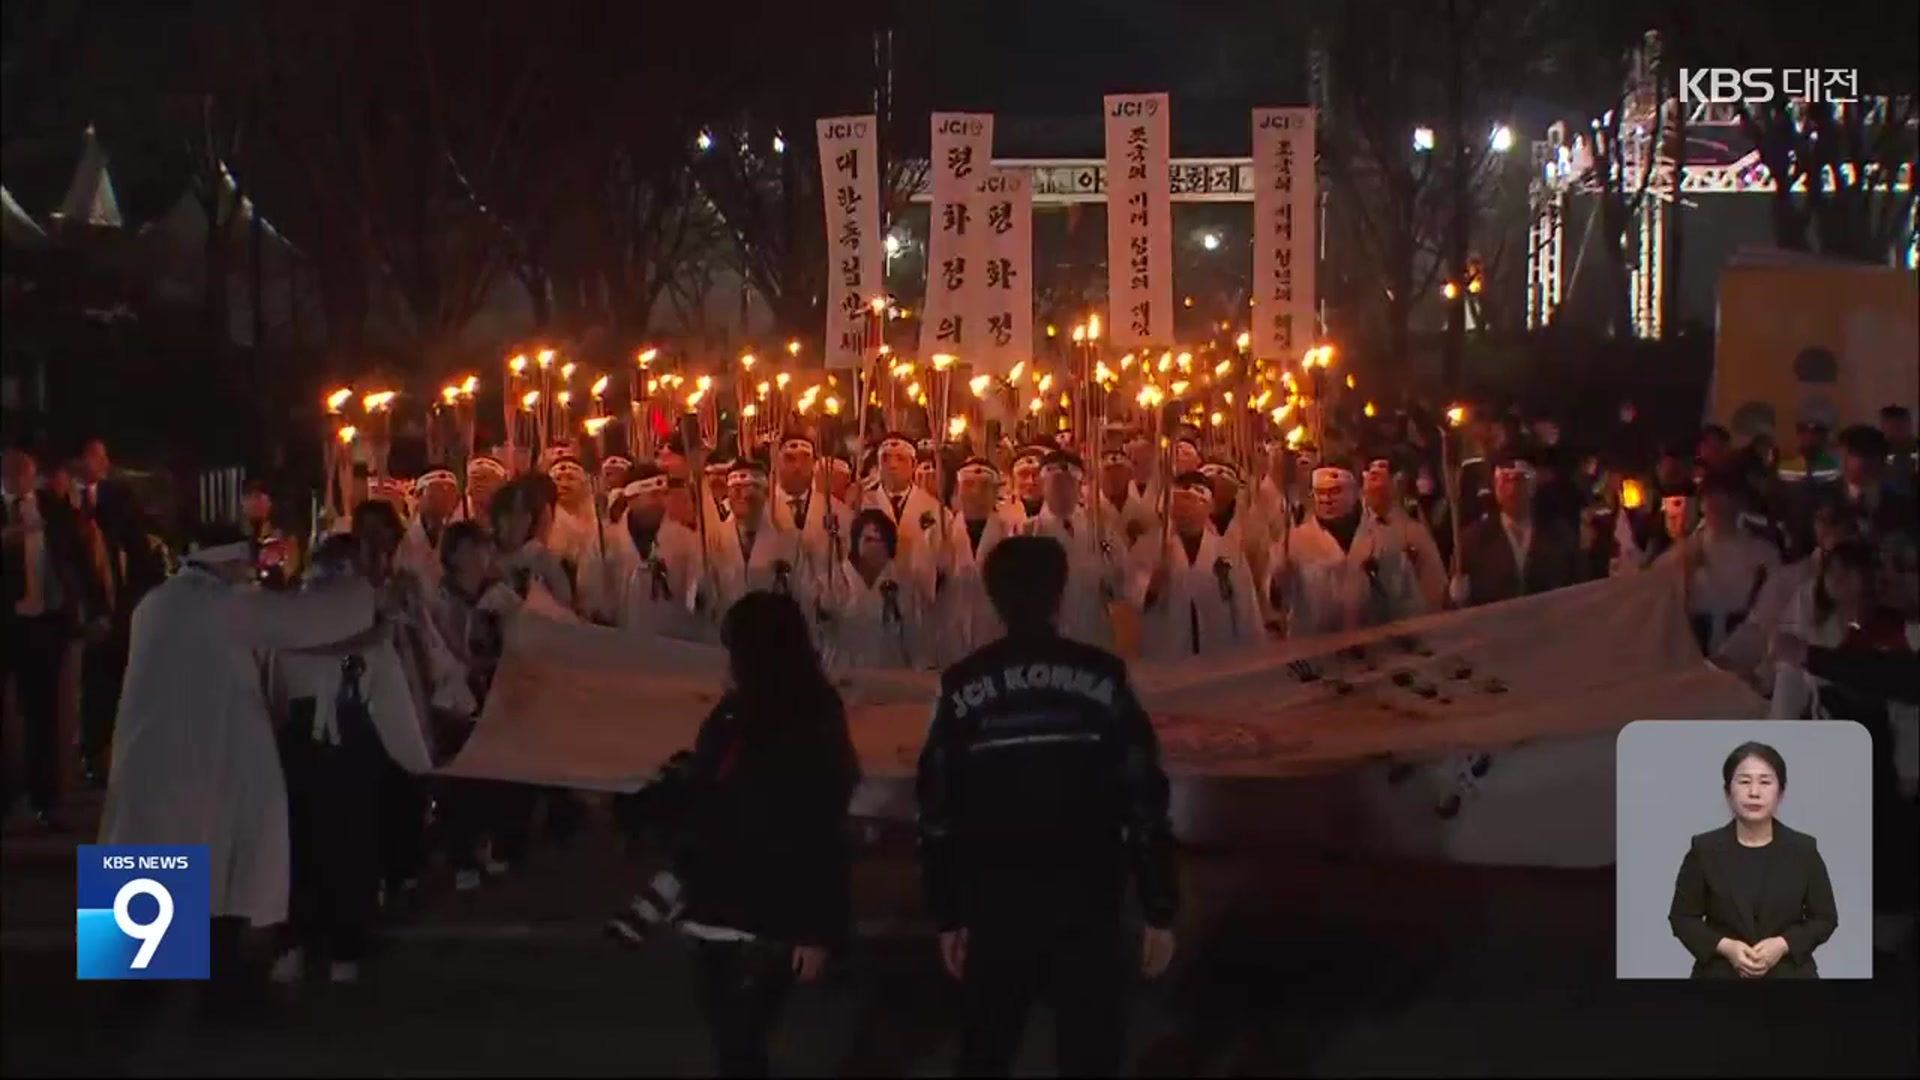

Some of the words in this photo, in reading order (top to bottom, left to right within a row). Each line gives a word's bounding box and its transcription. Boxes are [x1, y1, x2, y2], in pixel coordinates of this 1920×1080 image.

[1112, 102, 1141, 117] JCI
[939, 120, 967, 135] JCI
[1260, 115, 1289, 129] JCI
[825, 123, 851, 139] JCI
[976, 176, 1005, 192] JCI
[952, 675, 998, 718] JCI
[1004, 663, 1114, 706] KOREA
